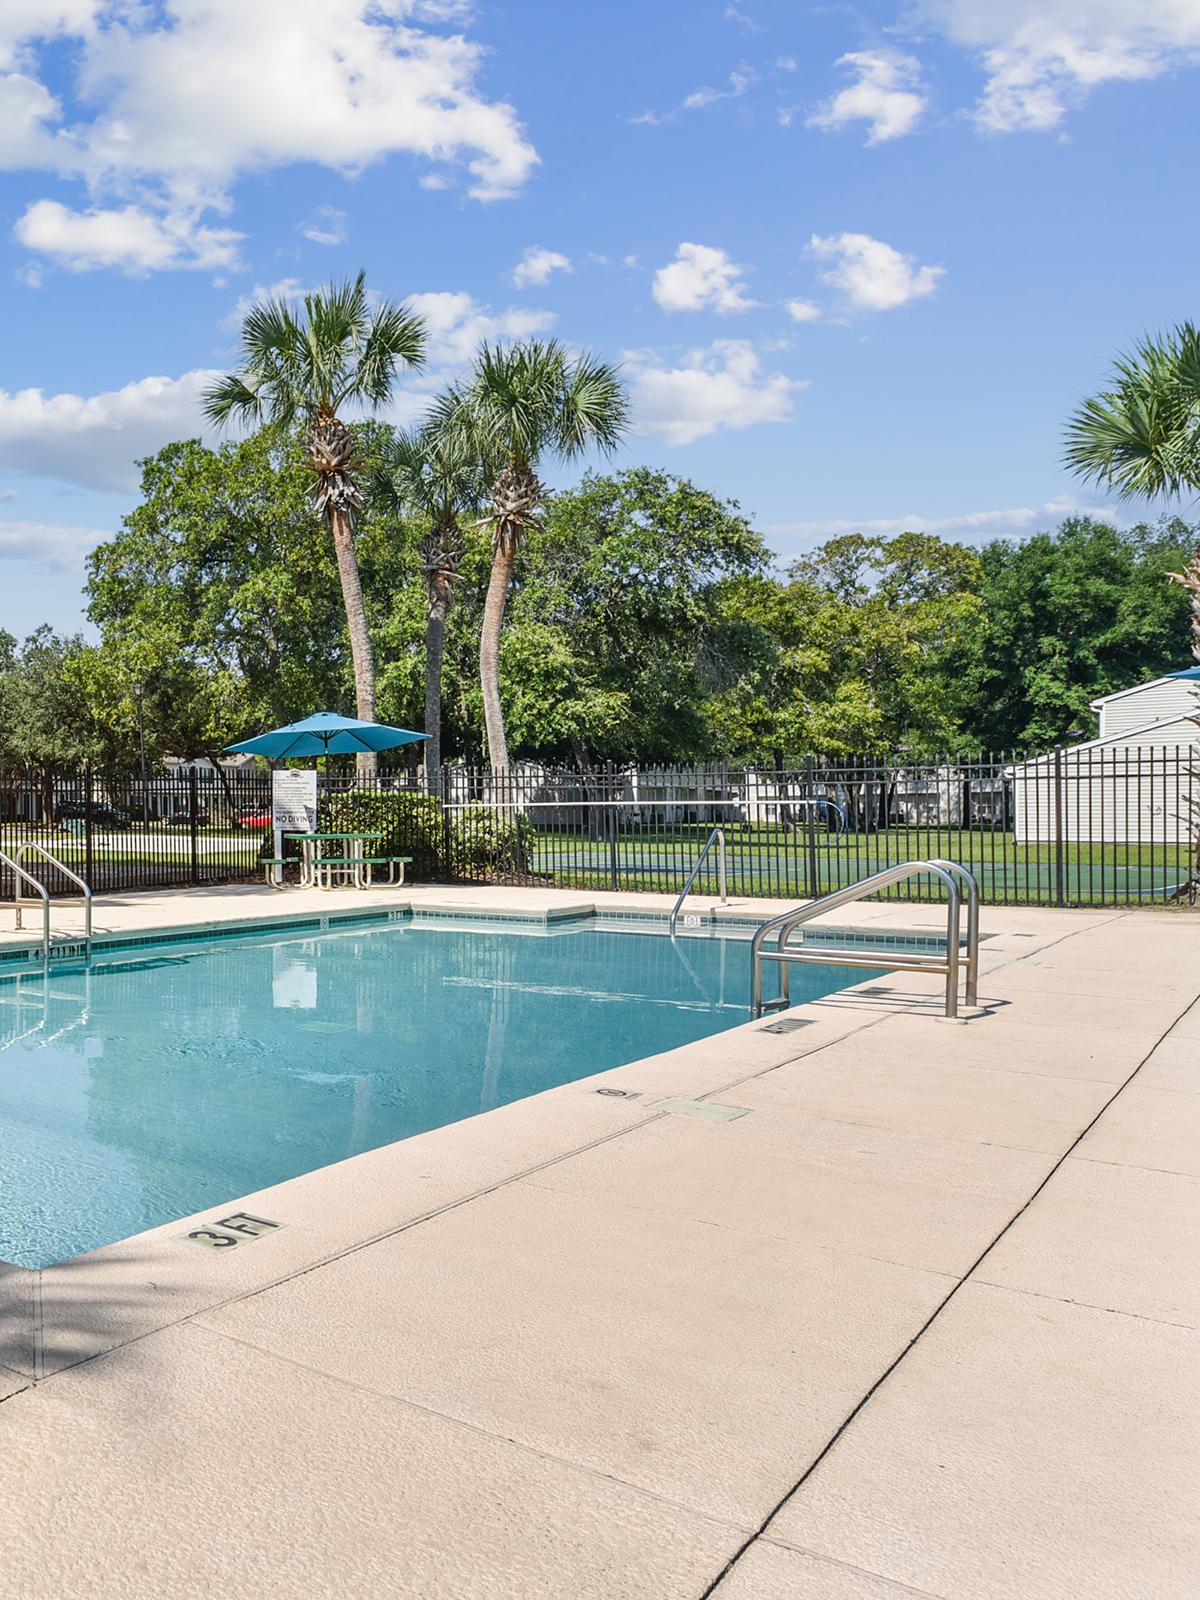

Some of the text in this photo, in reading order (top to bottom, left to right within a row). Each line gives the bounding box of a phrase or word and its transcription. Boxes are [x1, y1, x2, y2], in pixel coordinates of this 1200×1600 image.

[275, 815, 313, 823] NO DIVING
[188, 1212, 280, 1247] 3 FT
